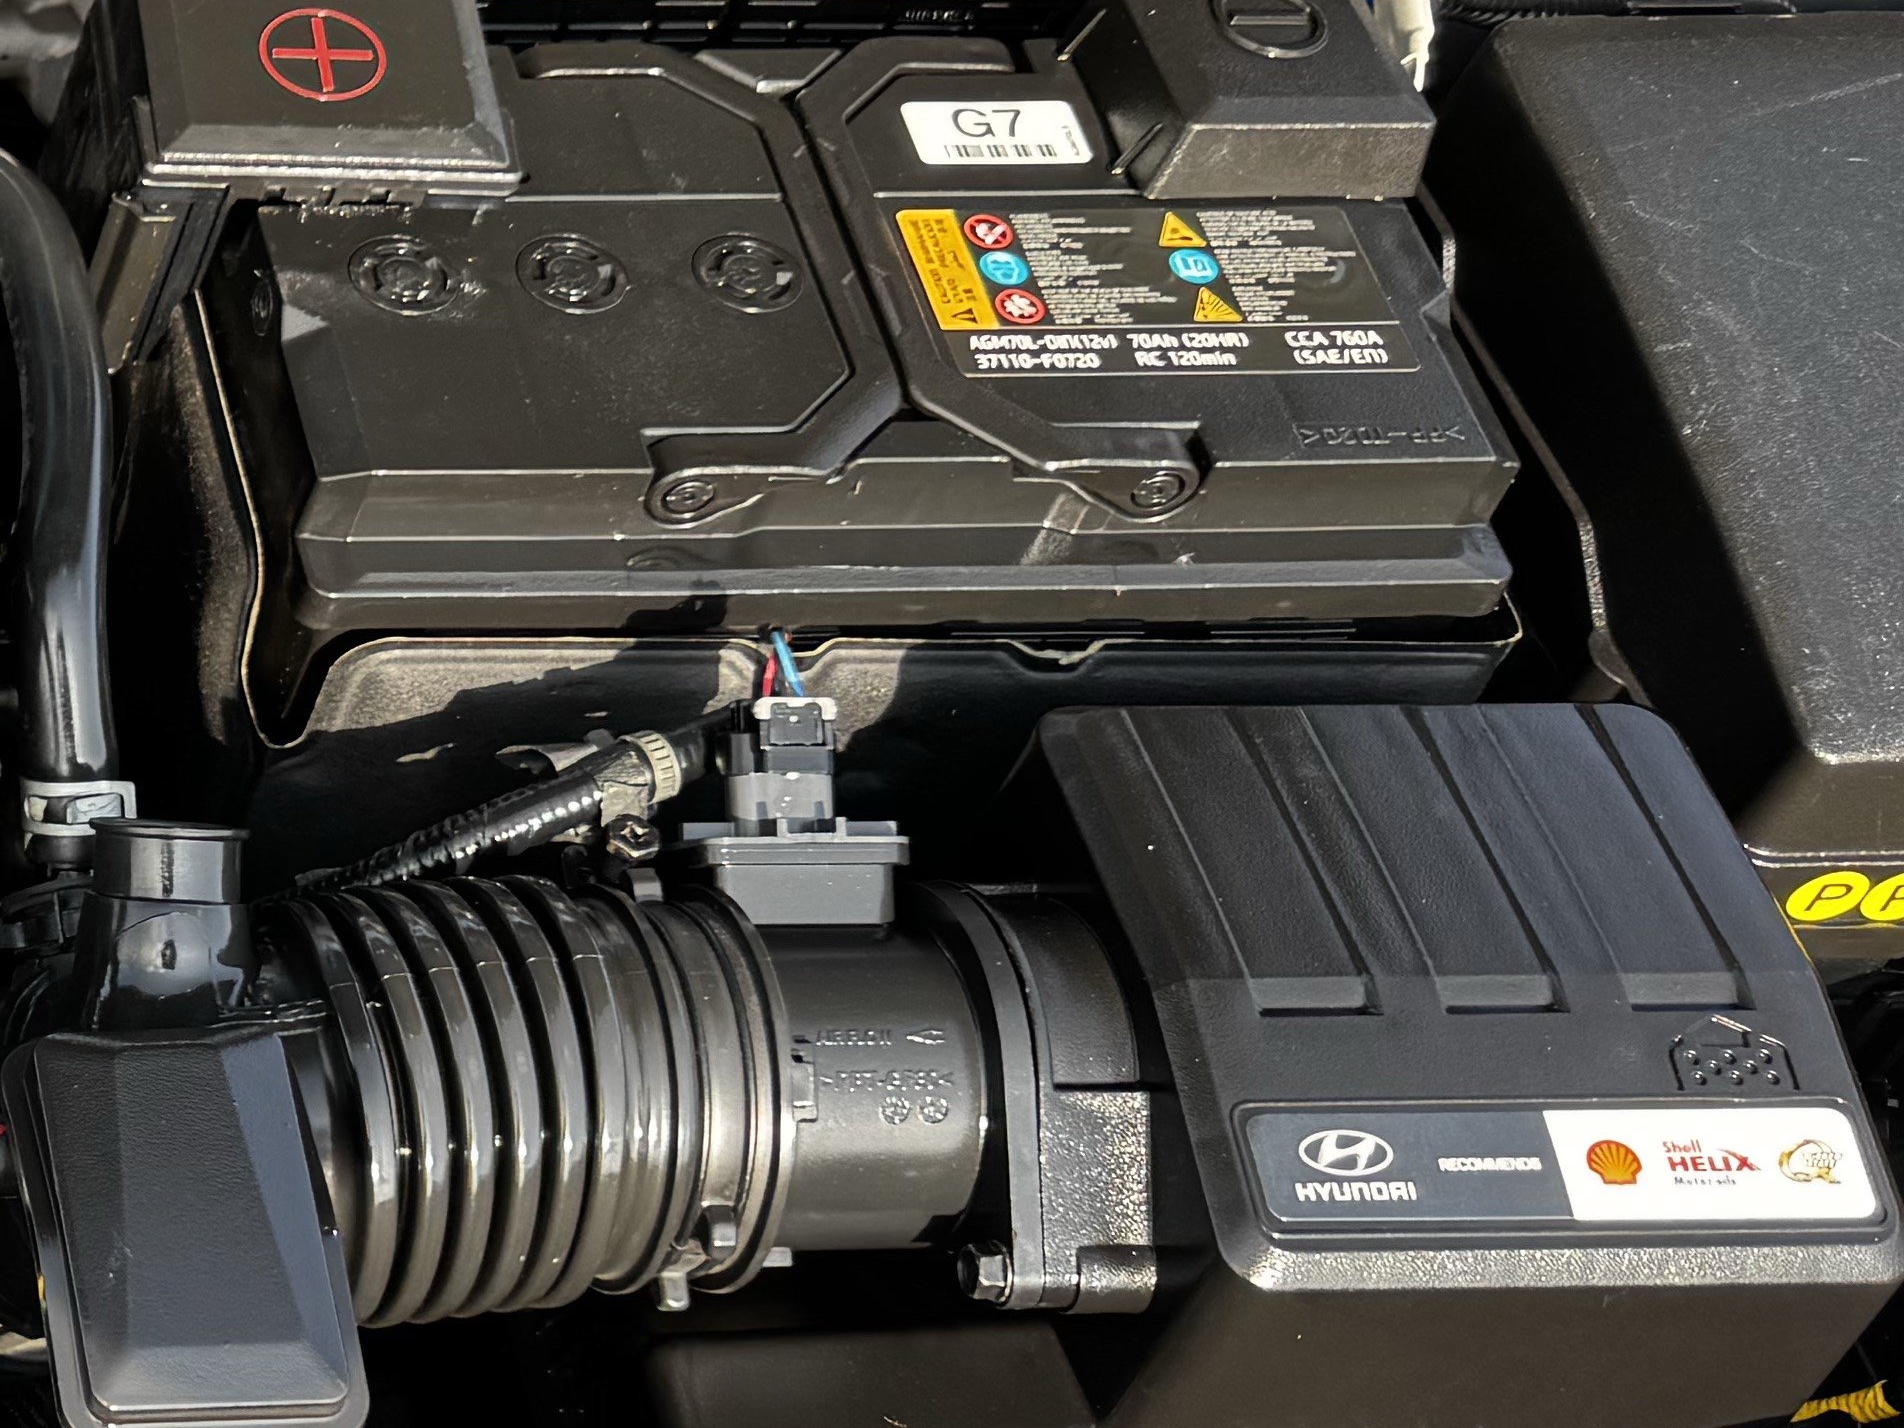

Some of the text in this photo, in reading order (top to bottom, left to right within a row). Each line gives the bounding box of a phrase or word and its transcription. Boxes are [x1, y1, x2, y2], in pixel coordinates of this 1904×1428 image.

[951, 108, 1021, 138] G7
[1667, 1149, 1761, 1172] HELIX
[1295, 1181, 1418, 1202] HYUNDAI
